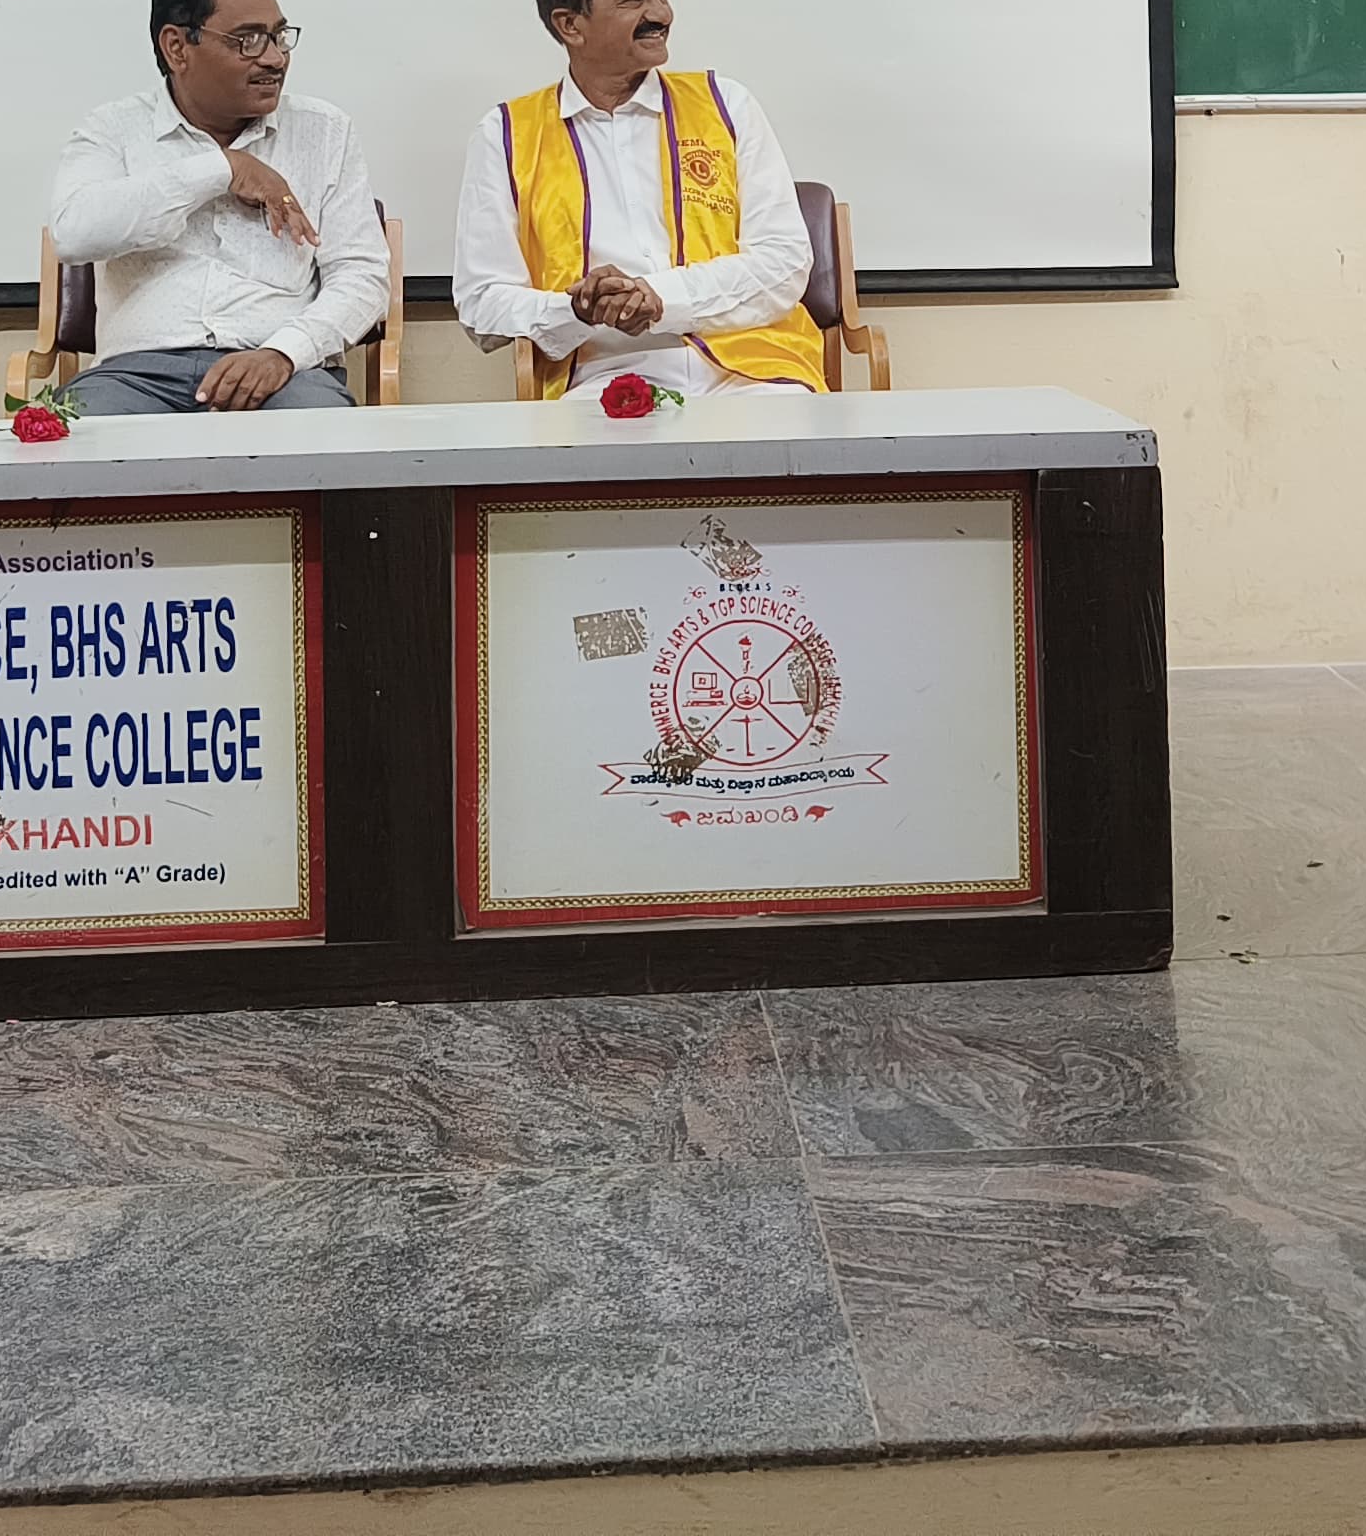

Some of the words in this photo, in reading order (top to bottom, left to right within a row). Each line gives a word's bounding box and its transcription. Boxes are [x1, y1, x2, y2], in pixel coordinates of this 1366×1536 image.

[49, 600, 127, 680] BHS
[137, 595, 238, 677] ARTS
[652, 647, 678, 676] BHS
[666, 615, 700, 651] ARTS
[697, 607, 710, 626] &
[708, 595, 736, 620] TGP
[739, 595, 796, 624] SCIENCE
[84, 707, 263, 790] COLLEGE
[696, 805, 799, 827] ಜಮಖಂಡಿ
[63, 866, 108, 888] with
[155, 862, 227, 886] Grade)
